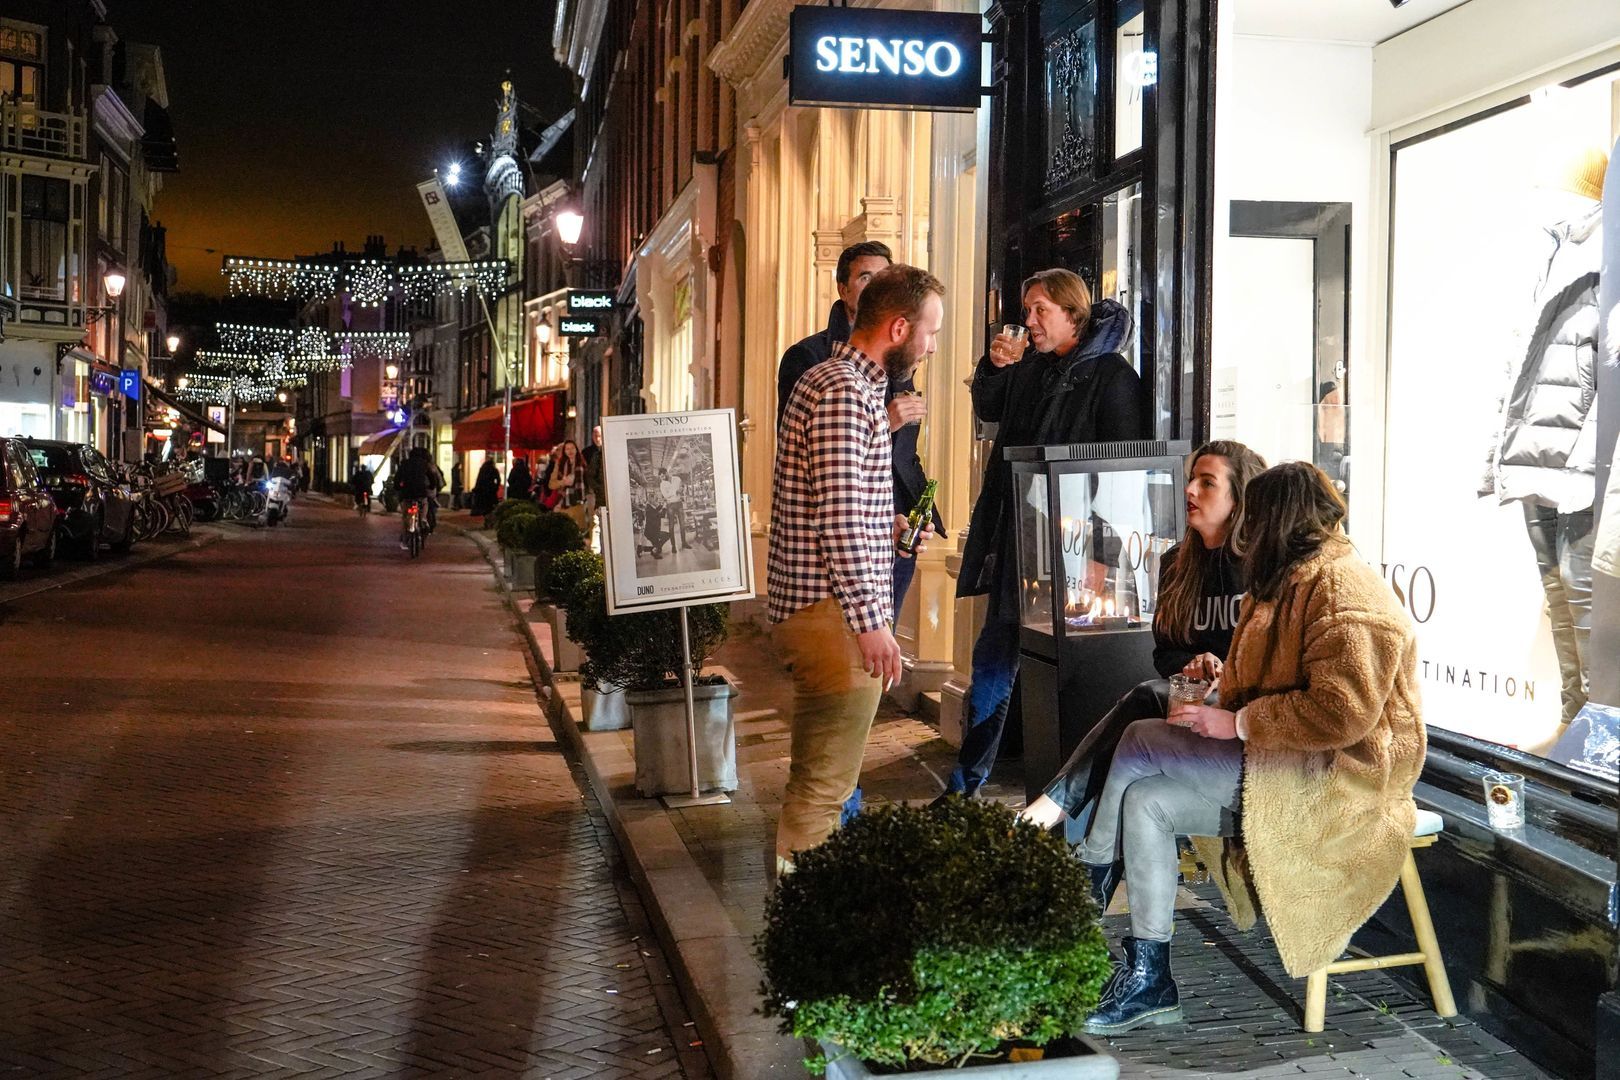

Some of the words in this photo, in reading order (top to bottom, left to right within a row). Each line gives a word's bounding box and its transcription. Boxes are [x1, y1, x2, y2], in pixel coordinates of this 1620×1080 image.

[816, 36, 962, 77] SENSO
[571, 295, 612, 308] black
[561, 321, 596, 333] black
[124, 377, 133, 391] P
[653, 416, 689, 426] SENSO
[637, 584, 655, 596] DUNO
[1194, 593, 1245, 630] UNO
[1422, 660, 1535, 701] TINATION
